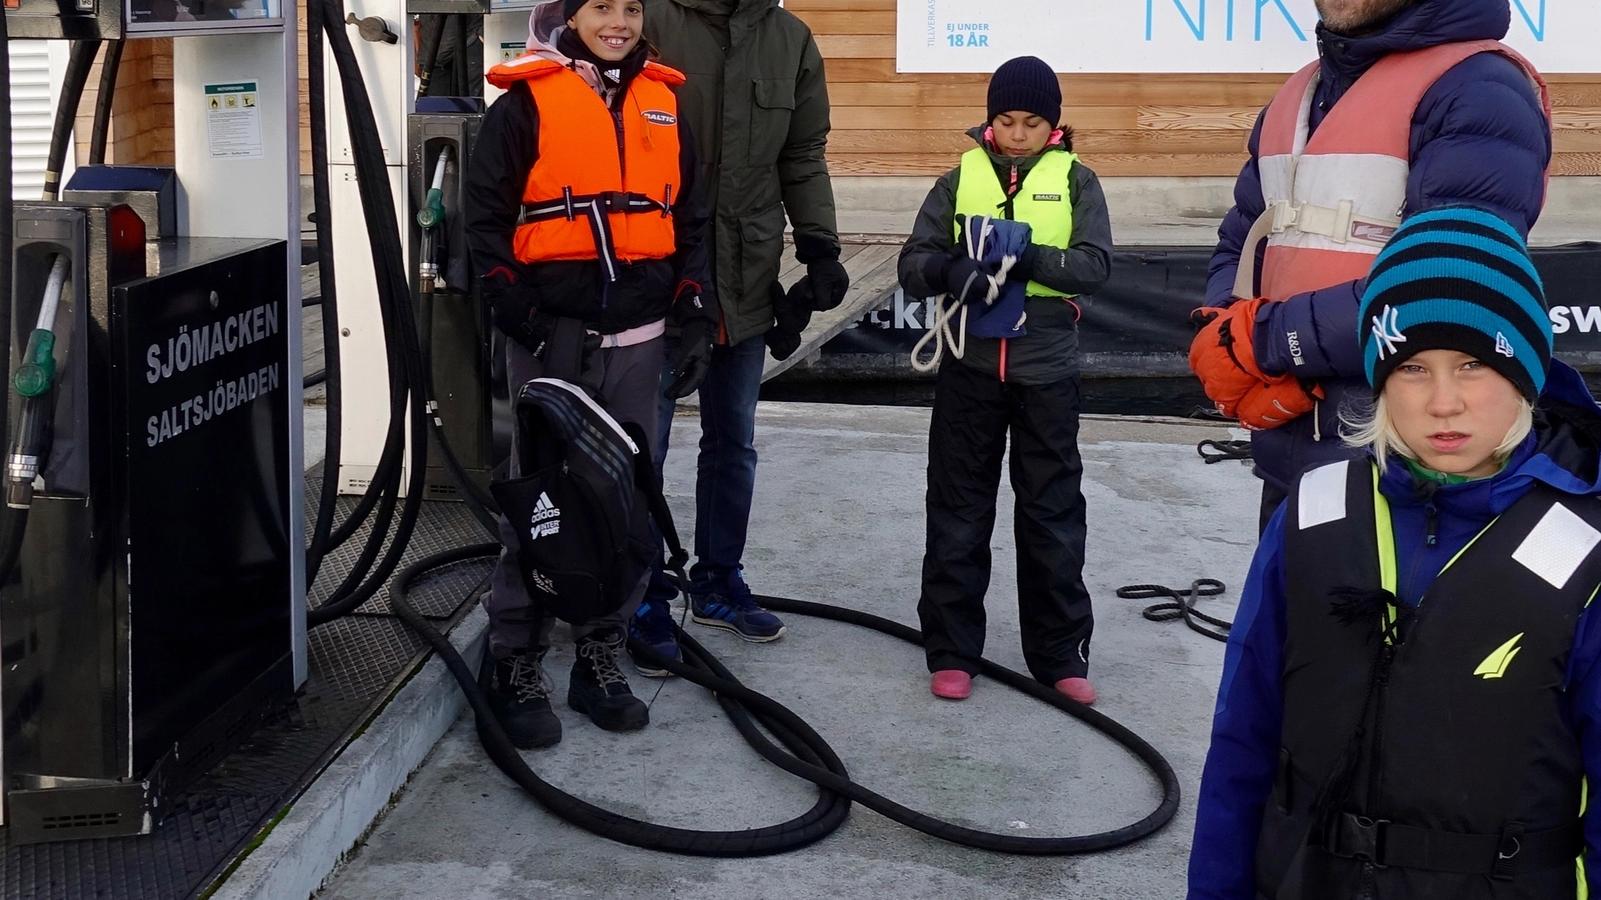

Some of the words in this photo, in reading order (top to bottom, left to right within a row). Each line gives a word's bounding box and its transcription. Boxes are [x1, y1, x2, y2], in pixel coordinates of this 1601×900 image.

[947, 23, 955, 32] EJ
[957, 23, 990, 31] UNDER
[946, 34, 964, 47] 18
[966, 31, 989, 48] ÅR
[146, 301, 279, 384] SJÖMACKEN
[1286, 331, 1302, 357] R&D
[146, 362, 279, 448] SALTSJÖBADEN
[531, 508, 561, 523] adidas
